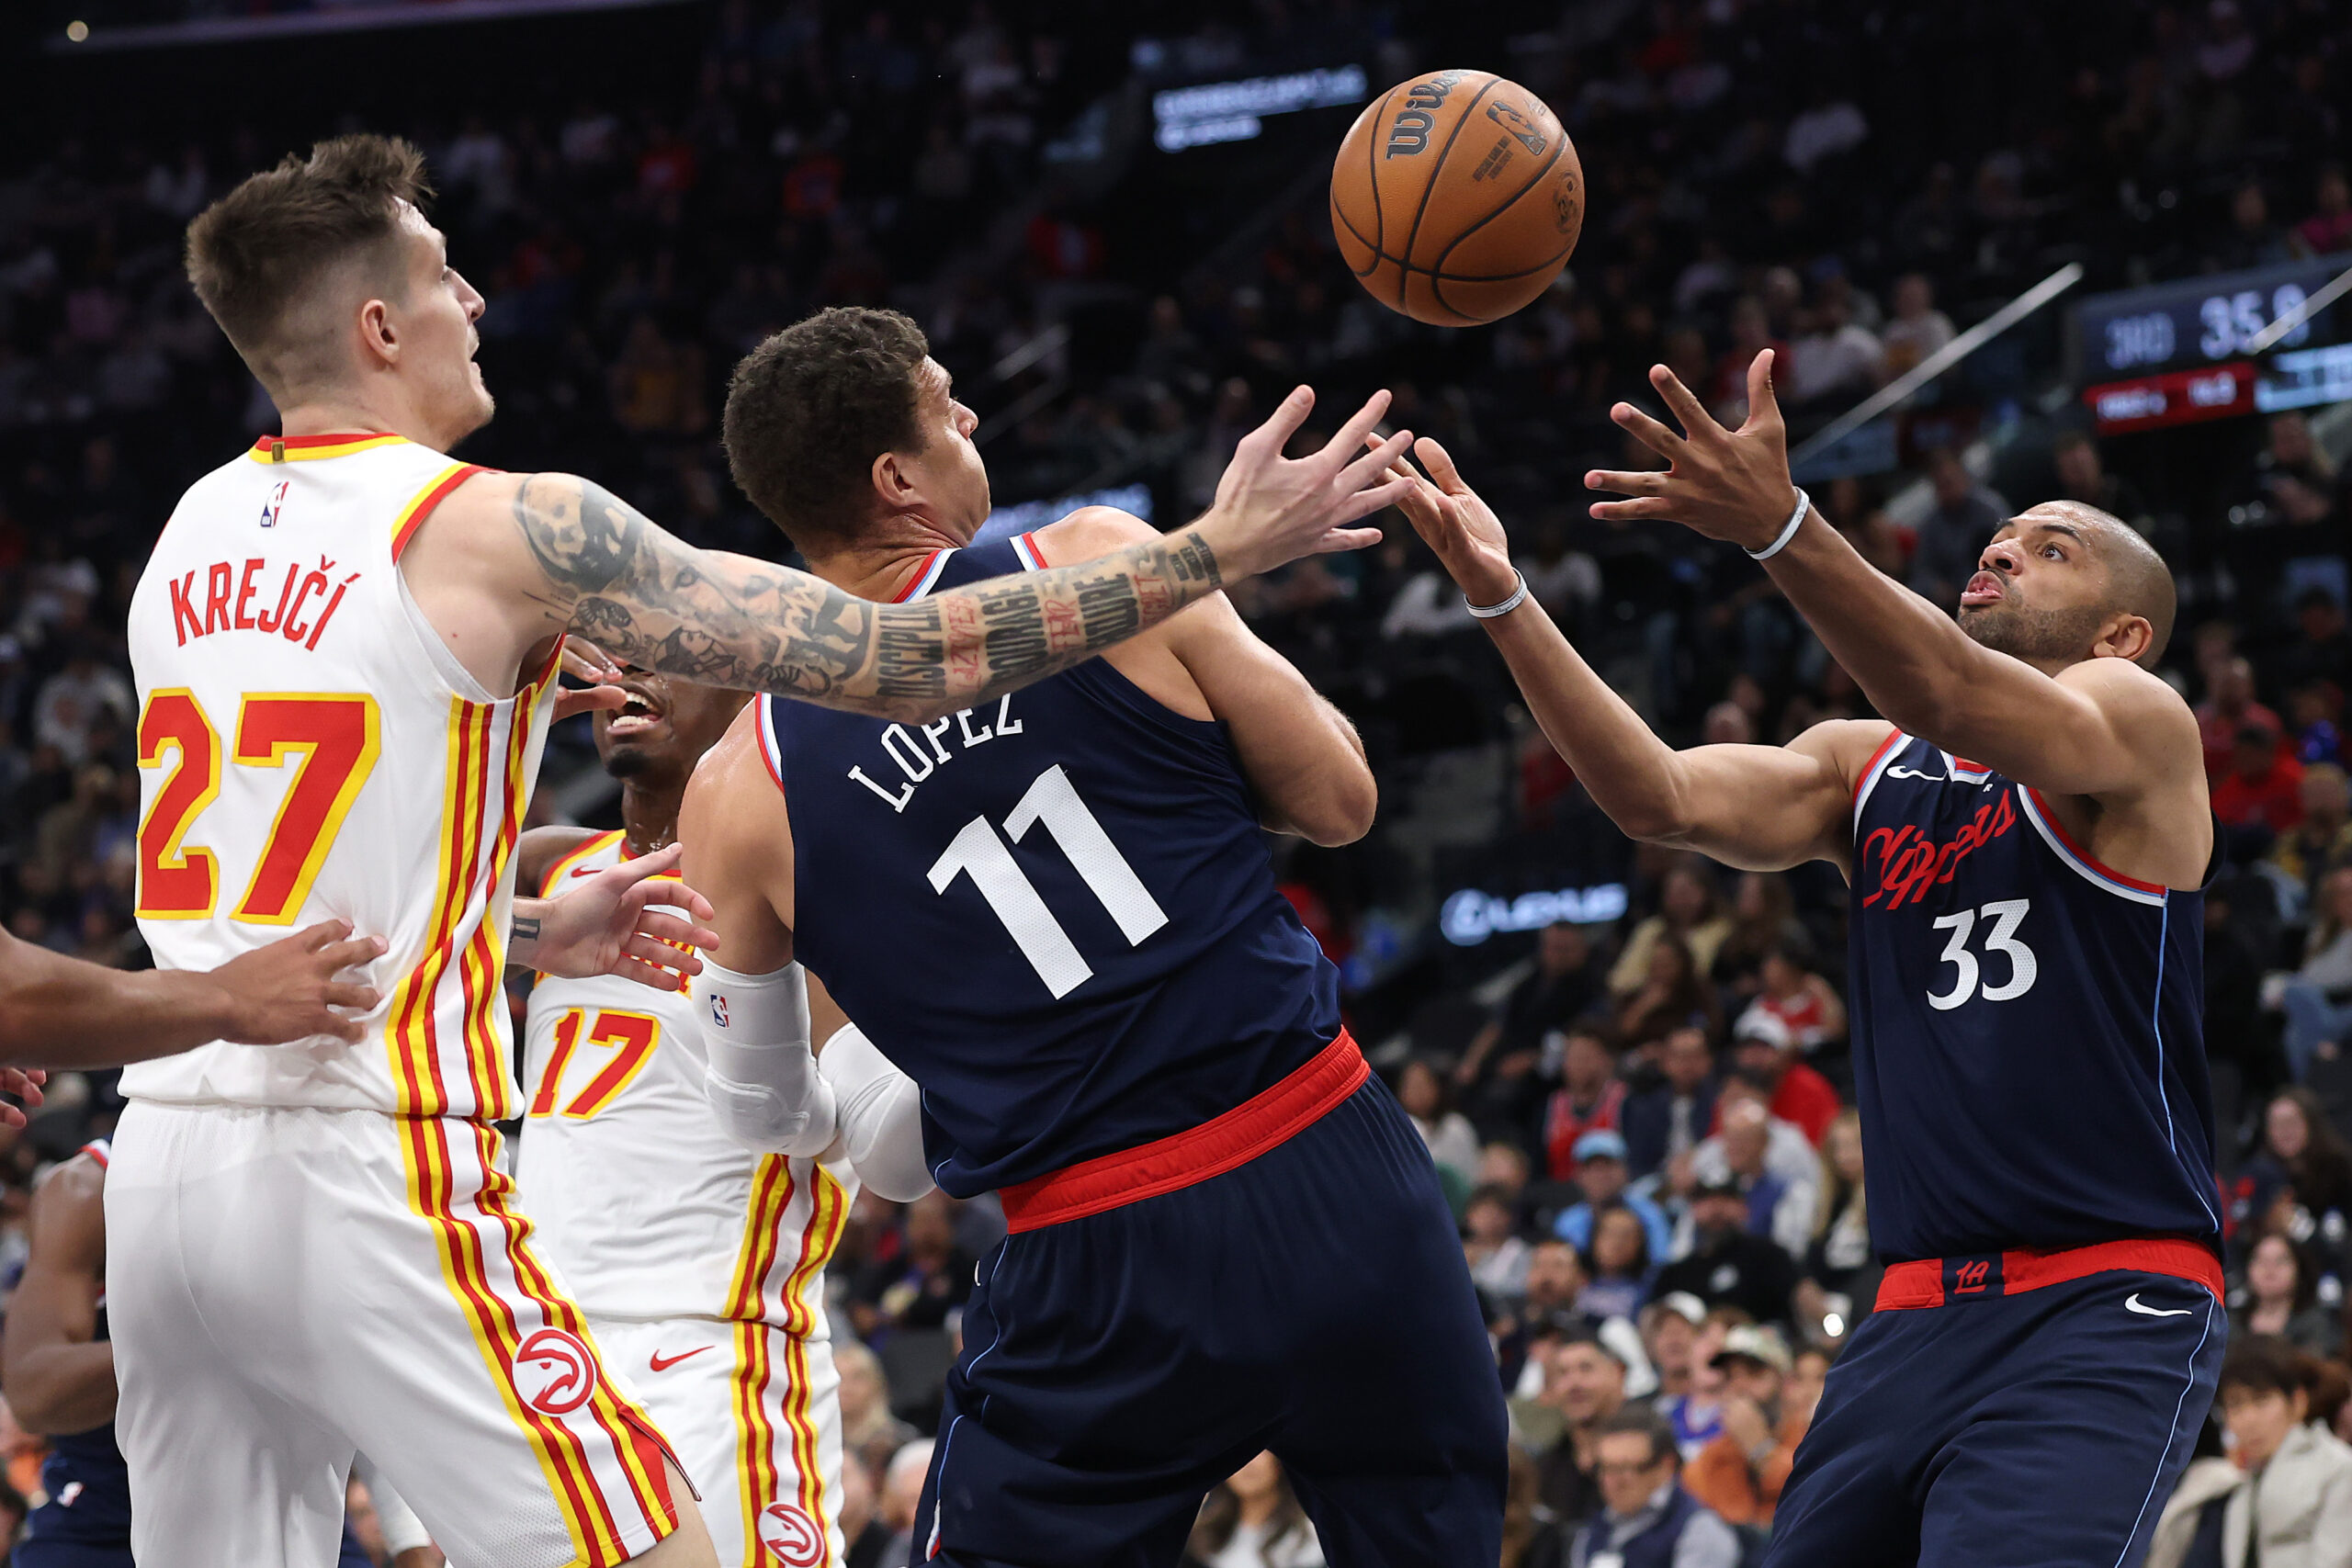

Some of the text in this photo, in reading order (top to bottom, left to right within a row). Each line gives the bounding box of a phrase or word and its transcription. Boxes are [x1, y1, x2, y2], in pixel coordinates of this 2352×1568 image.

[169, 553, 362, 651] KREJČÍ
[133, 687, 381, 926] 27
[847, 693, 1023, 814] LOPEZ
[926, 763, 1170, 1000] 11
[1863, 787, 2017, 910] Clippers
[1926, 898, 2038, 1011] 33
[527, 1007, 662, 1121] 17
